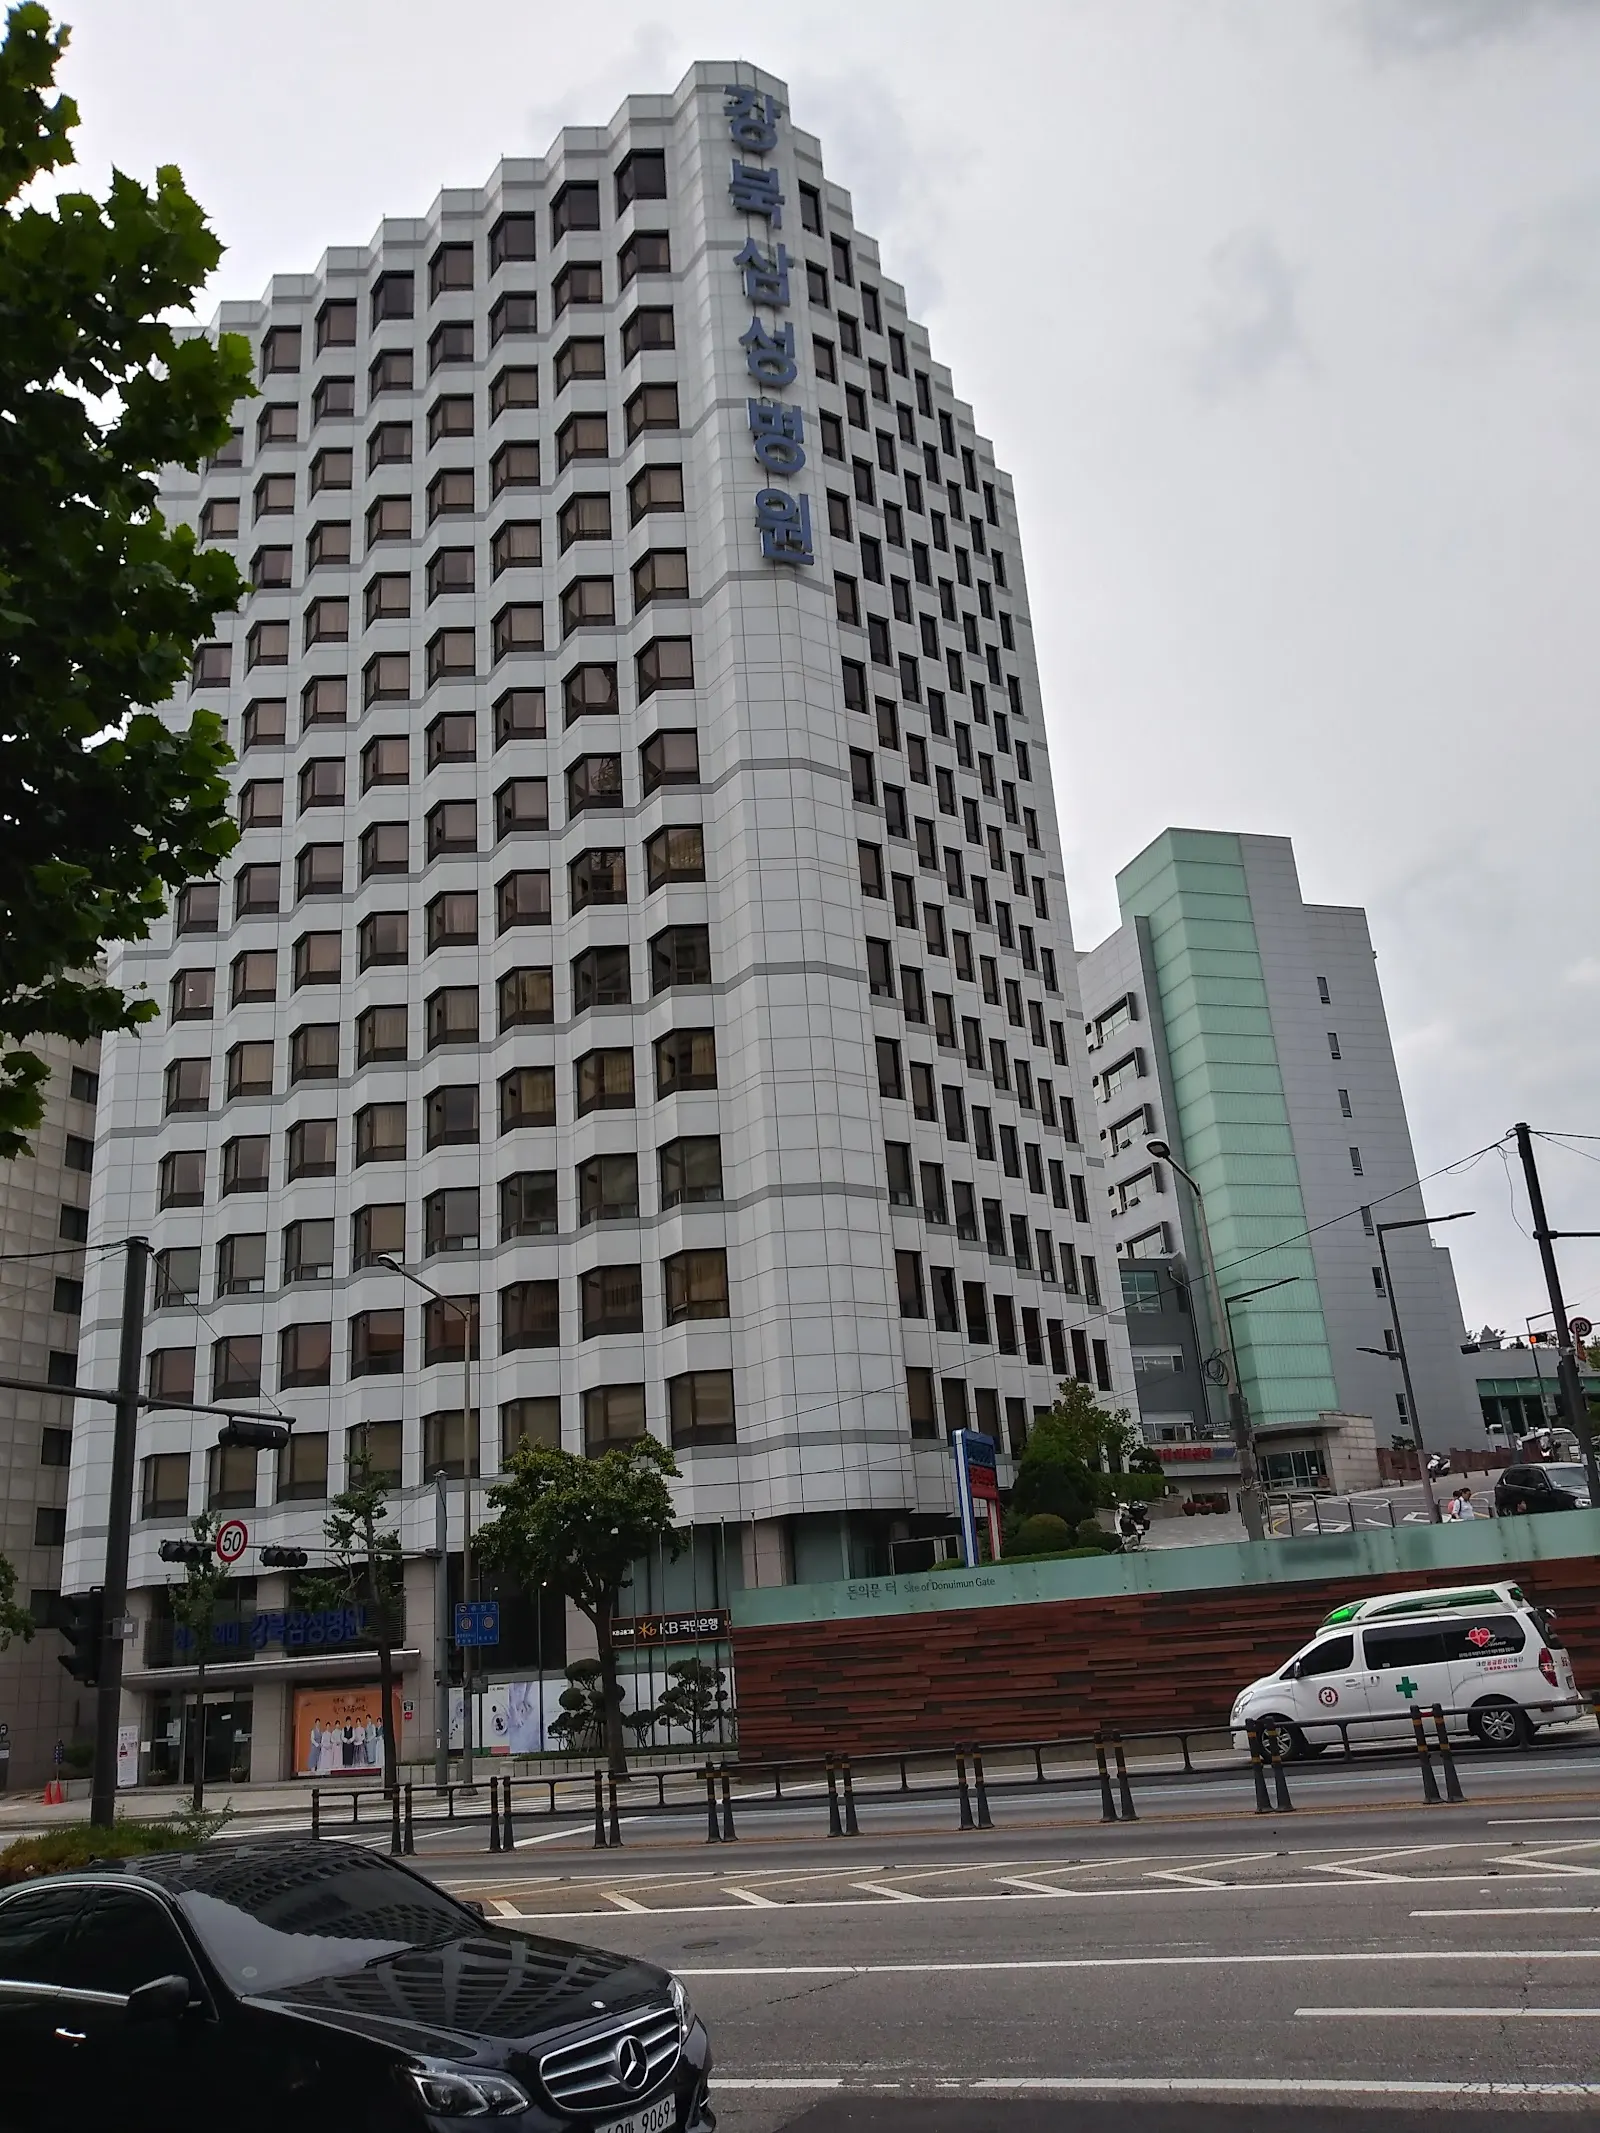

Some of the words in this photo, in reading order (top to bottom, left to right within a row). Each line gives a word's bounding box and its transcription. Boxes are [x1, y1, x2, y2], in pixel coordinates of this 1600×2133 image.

[722, 84, 815, 567] 강북삼성병원
[222, 1531, 242, 1552] 50
[846, 1583, 882, 1600] 돈의문
[885, 1580, 898, 1596] 터
[903, 1580, 920, 1594] Site
[921, 1581, 931, 1592] of
[932, 1579, 975, 1592] Donuimun
[975, 1577, 996, 1588] Gate
[249, 1606, 366, 1650] 강북삼성병원
[641, 2100, 671, 2133] 9069
